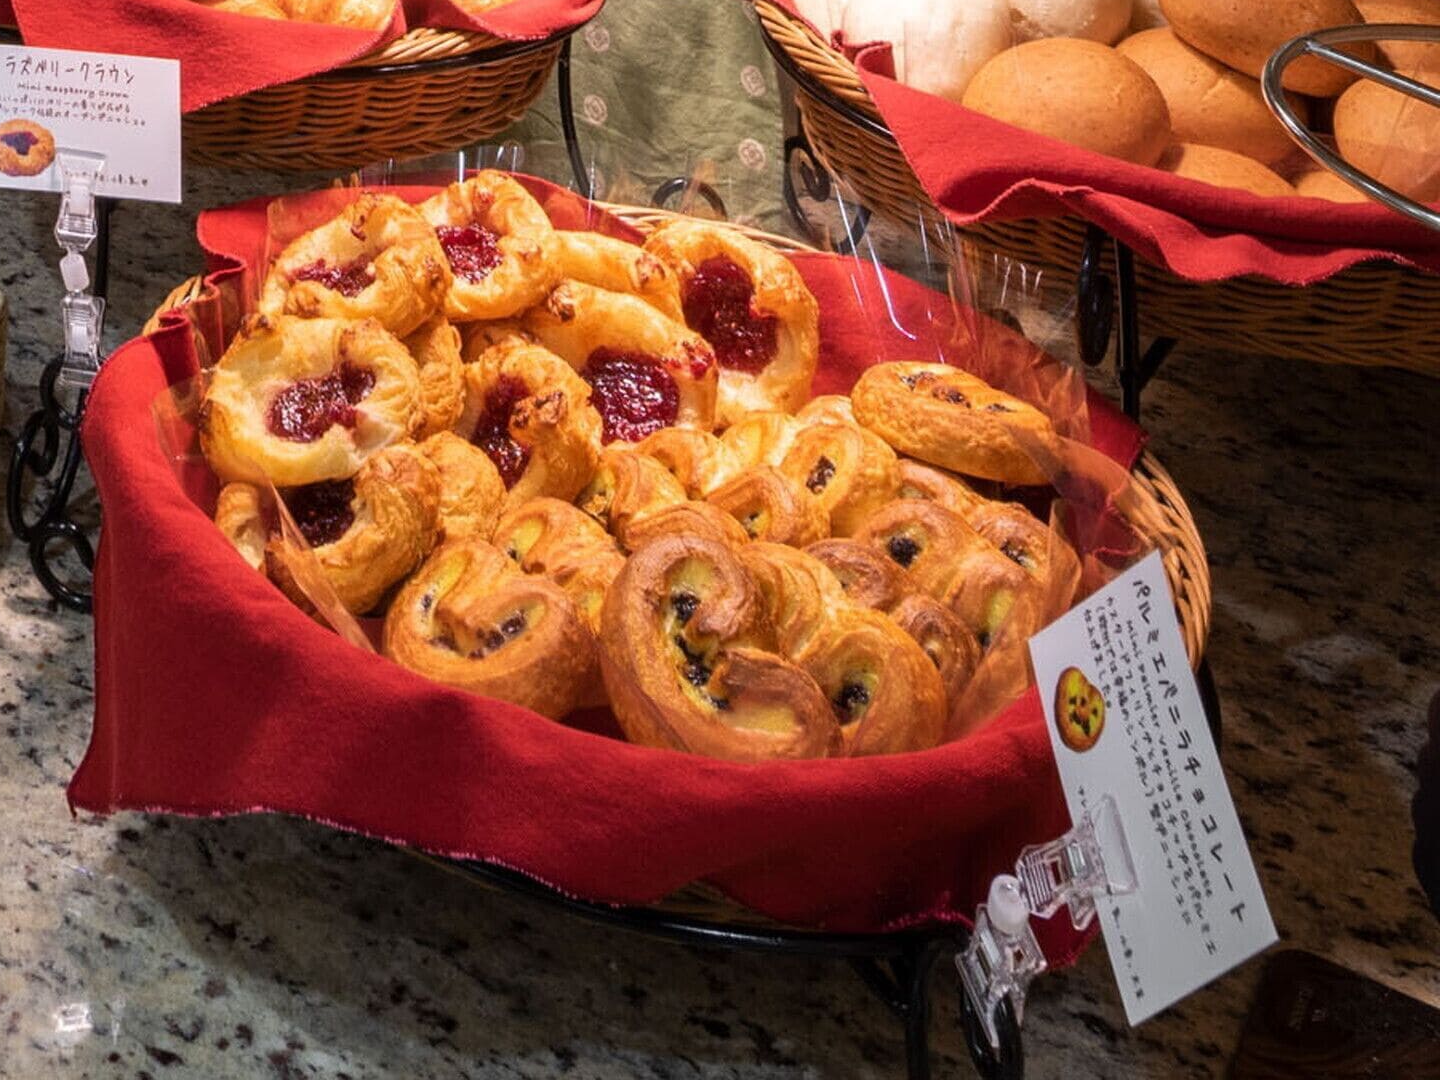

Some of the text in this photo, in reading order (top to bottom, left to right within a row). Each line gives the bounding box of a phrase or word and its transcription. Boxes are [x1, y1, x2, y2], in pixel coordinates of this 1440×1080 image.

[6, 56, 135, 84] ラズベリークラウン
[1128, 573, 1248, 929] パルミエバニラチョコレート
